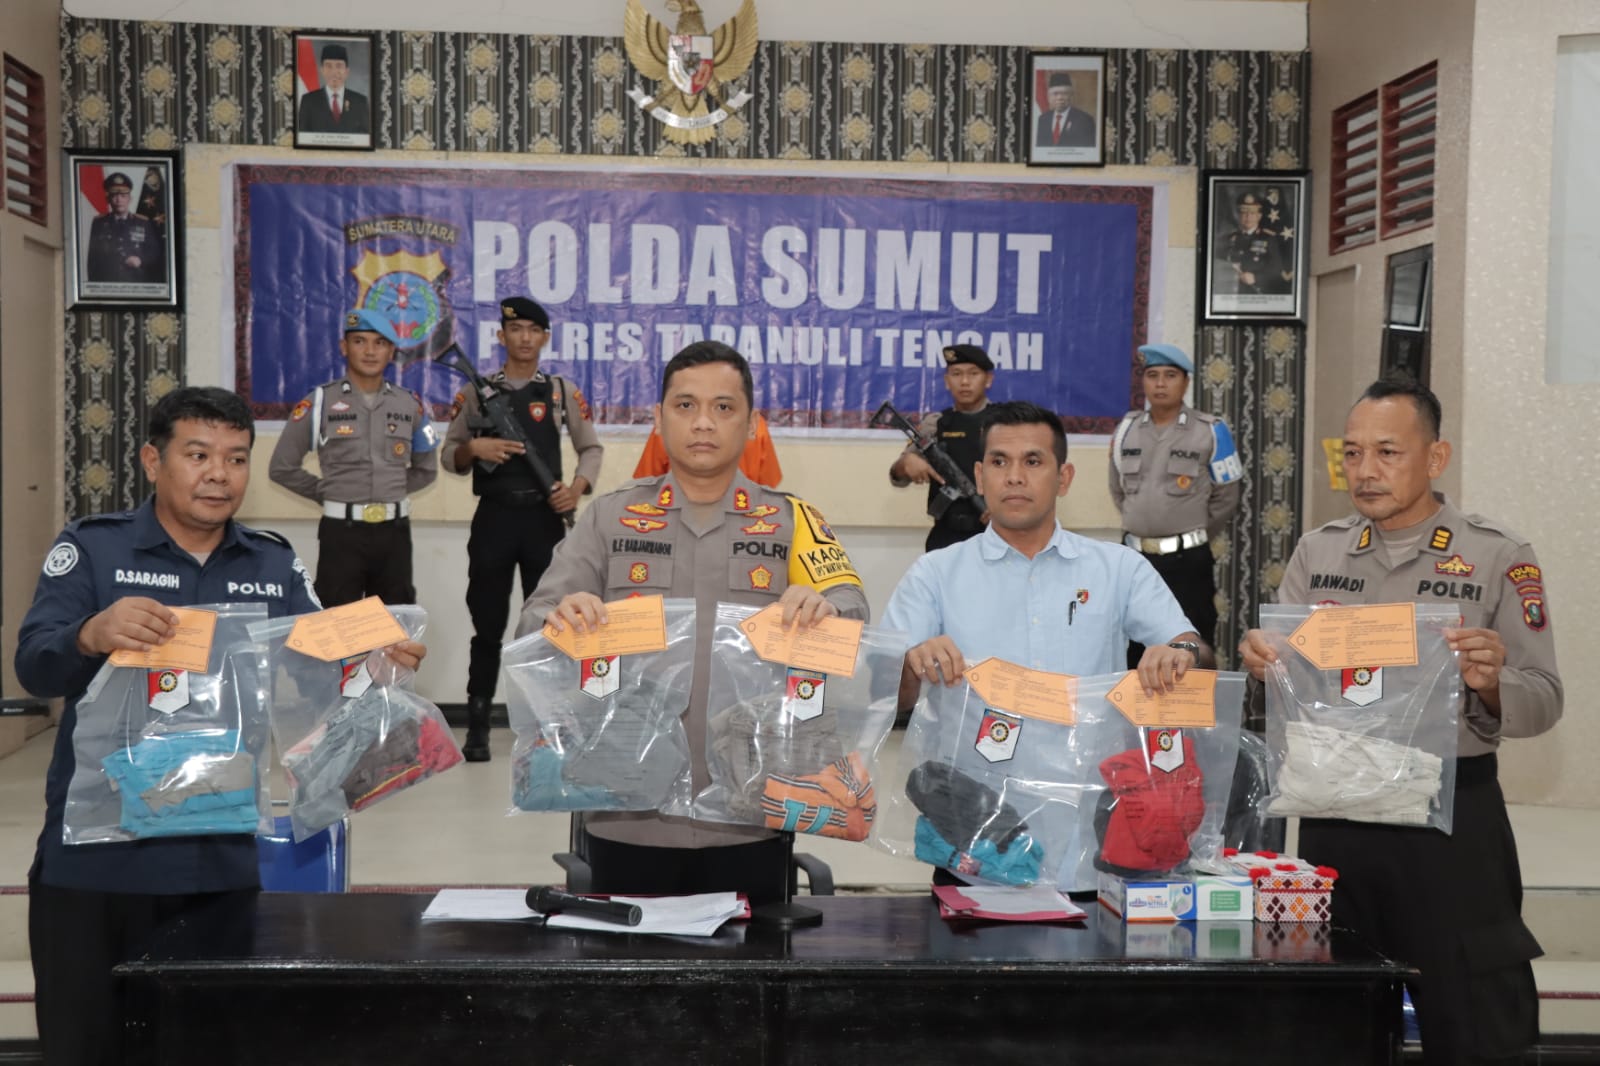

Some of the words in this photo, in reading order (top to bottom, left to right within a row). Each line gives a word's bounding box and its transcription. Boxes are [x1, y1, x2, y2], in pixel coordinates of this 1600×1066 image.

[349, 220, 414, 241] SUMATERA
[418, 222, 456, 243] UTARA
[473, 220, 739, 306] POLDA
[761, 225, 1053, 315] SUMUT
[479, 320, 643, 362] PLRES
[733, 541, 788, 561] POLRI
[115, 568, 180, 589] D.SARAGIH
[227, 581, 283, 597] POLRI
[1310, 574, 1365, 593] IRAWADI
[1417, 580, 1483, 601] POLRI
